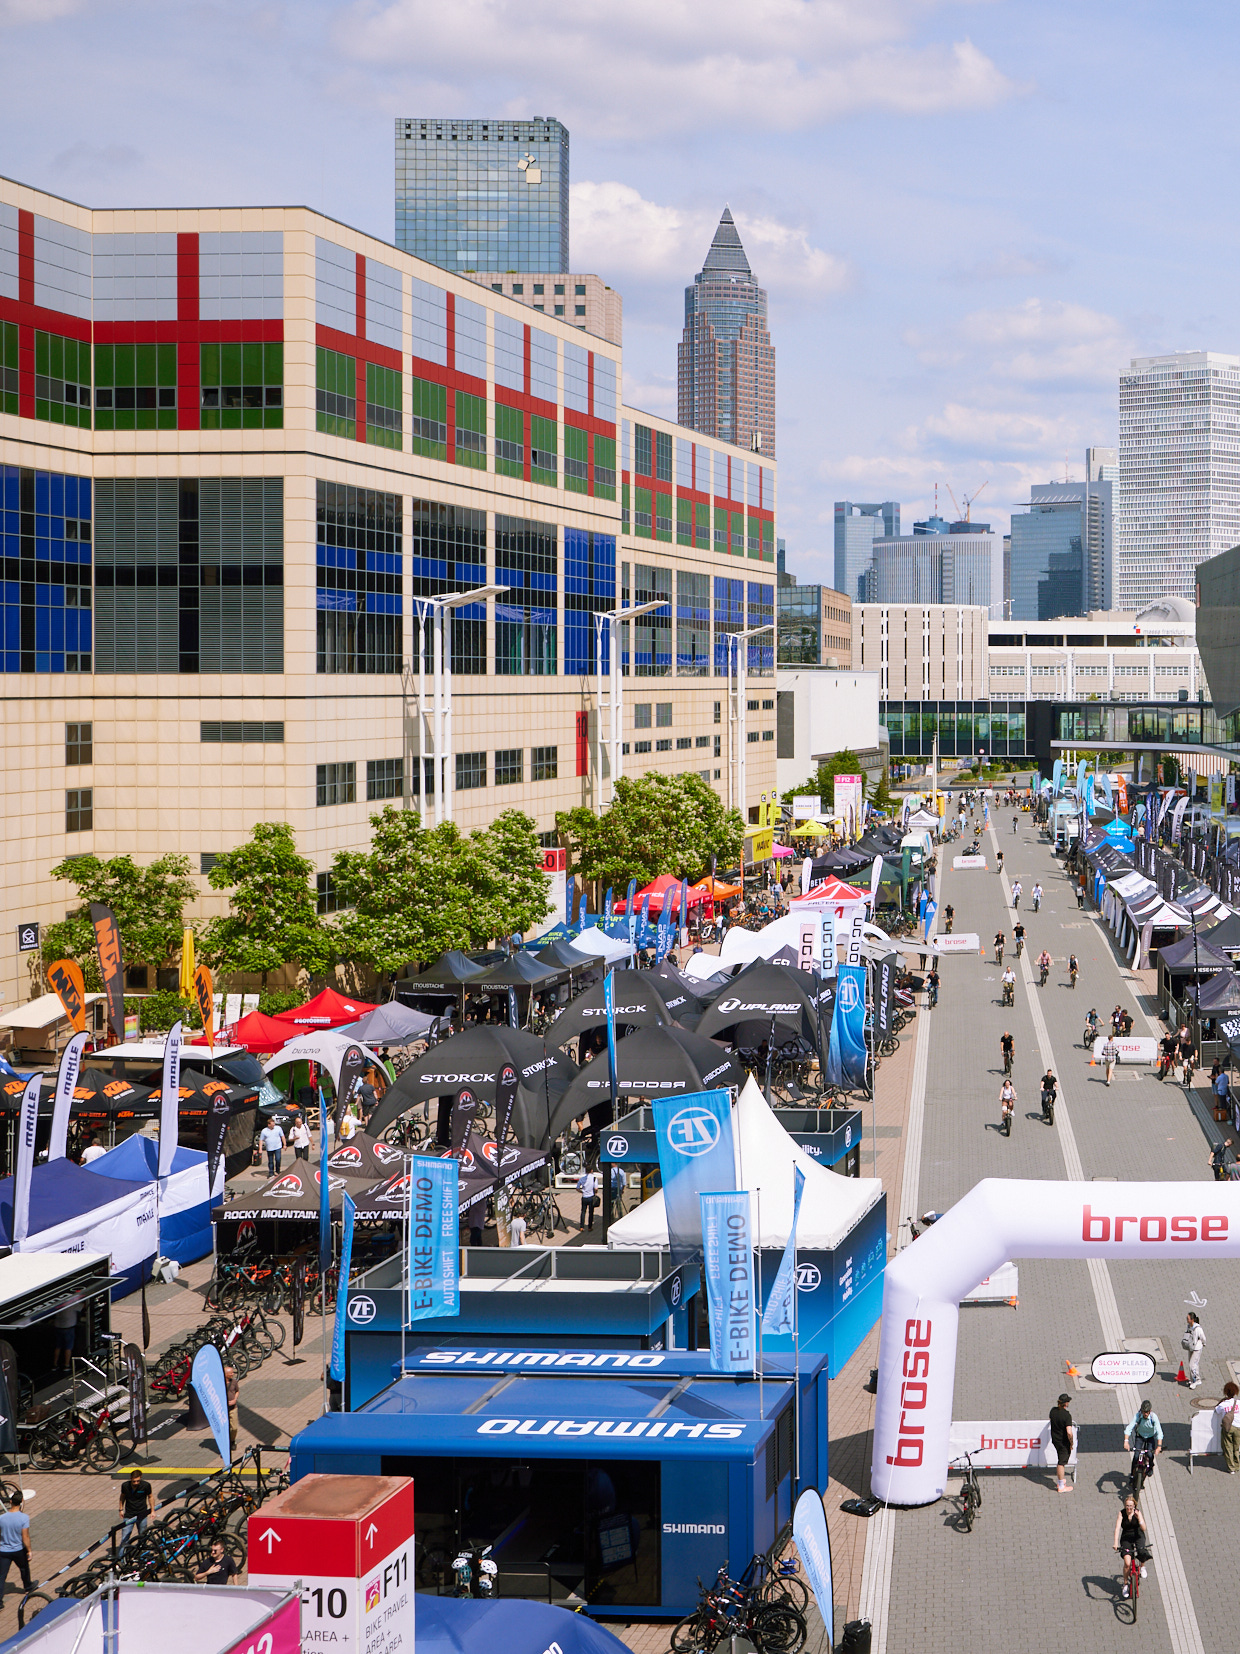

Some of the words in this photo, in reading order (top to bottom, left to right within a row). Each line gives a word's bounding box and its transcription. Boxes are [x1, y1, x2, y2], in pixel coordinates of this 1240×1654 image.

[944, 938, 967, 946] brose
[665, 995, 687, 1010] STORCK
[879, 963, 890, 1030] UPLAND
[739, 1003, 802, 1011] UPLAND
[291, 1047, 321, 1055] binova
[1118, 1044, 1141, 1052] rose
[63, 1045, 80, 1096] MAHLE
[170, 1038, 180, 1089] MAHLE
[521, 1056, 558, 1078] STORCK
[419, 1073, 496, 1084] STORCK
[102, 1081, 133, 1099] KTM
[25, 1091, 38, 1148] MAHLE
[416, 1160, 453, 1171] SHIMANO
[223, 1210, 259, 1220] ROCKY
[353, 1211, 380, 1220] OCKY
[415, 1177, 433, 1239] DEMO
[441, 1179, 453, 1237] FREESHIFT
[458, 1199, 471, 1214] OCKY
[1082, 1204, 1229, 1242] brose
[414, 1246, 433, 1310] E-BIKE
[442, 1250, 455, 1306] AUTOSHIFT
[419, 1351, 666, 1368] SHIMANO
[886, 1318, 932, 1468] brose
[476, 1418, 747, 1439] SHIMANO
[980, 1434, 1041, 1451] brose
[662, 1523, 726, 1535] SHIMANO
[384, 1552, 408, 1598] F11
[365, 1617, 382, 1638] BIKE
[383, 1596, 409, 1626] TRAVEL
[305, 1630, 338, 1642] AREA
[366, 1635, 385, 1654] AREA
